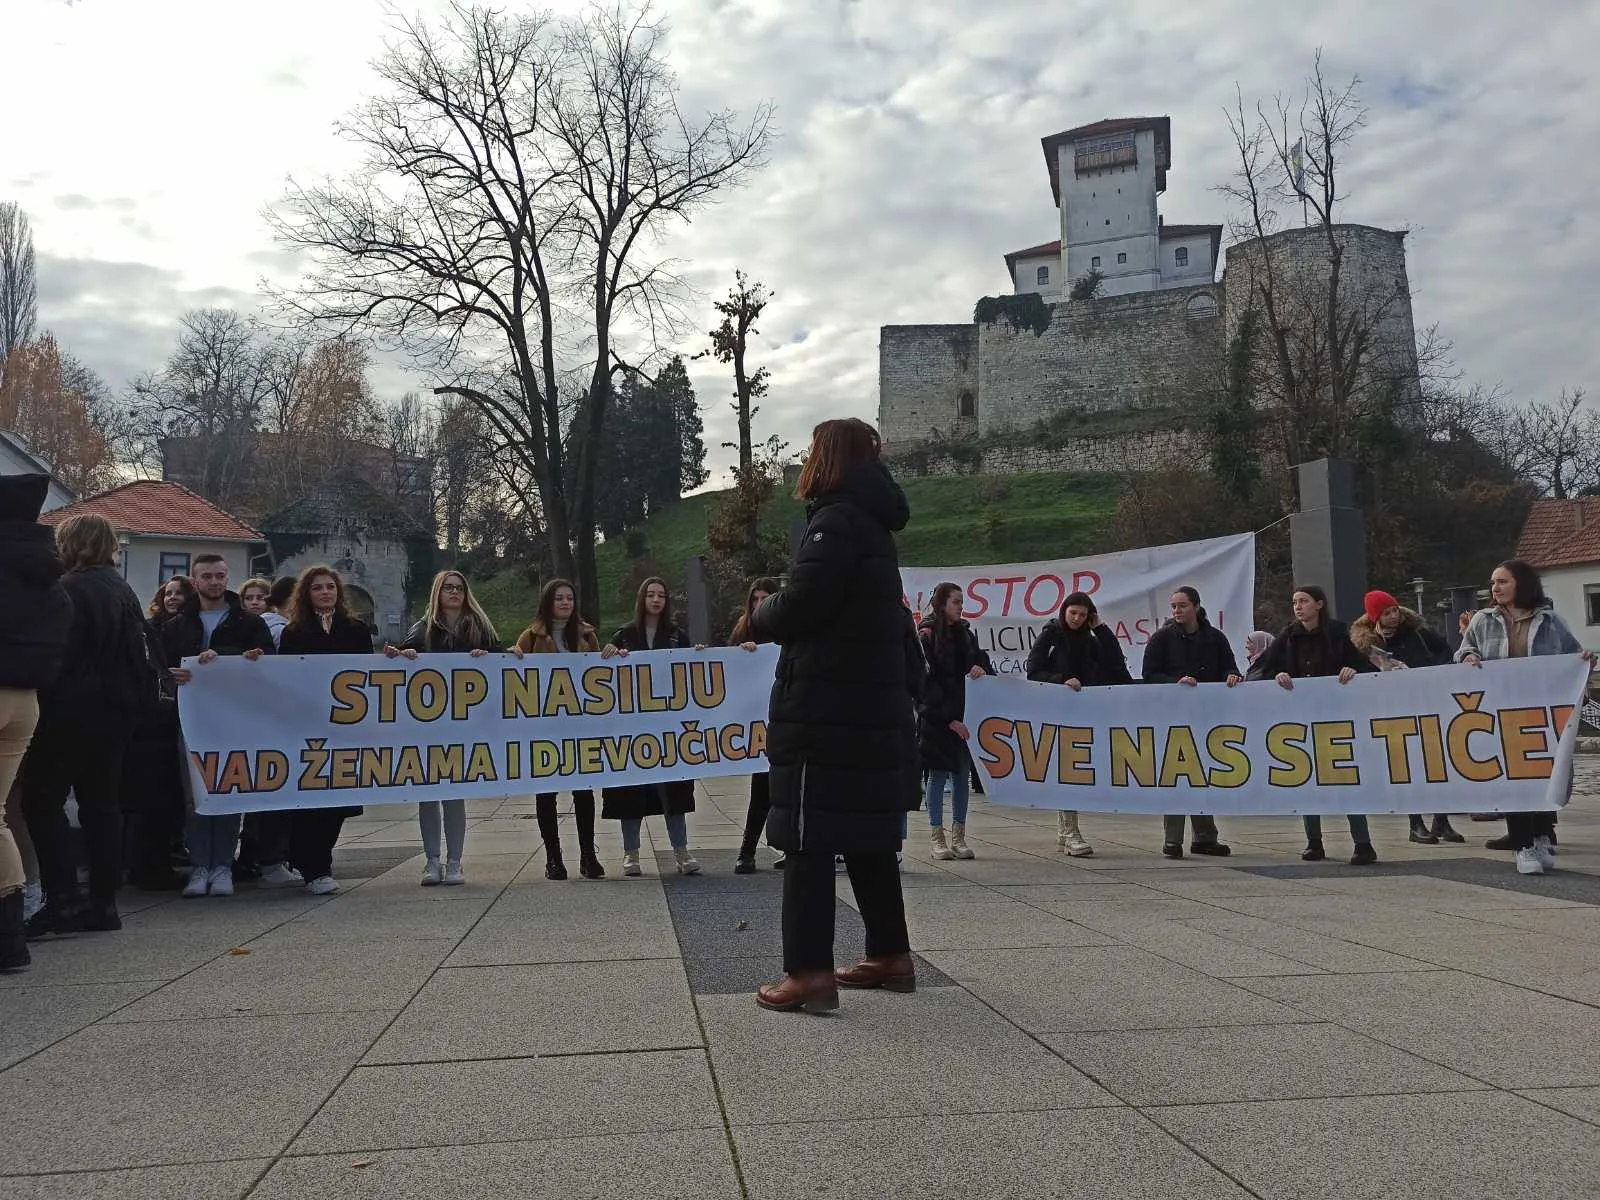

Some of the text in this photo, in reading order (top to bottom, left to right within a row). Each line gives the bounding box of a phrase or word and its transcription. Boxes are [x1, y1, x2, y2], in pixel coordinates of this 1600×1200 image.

[961, 570, 1102, 619] STOP
[330, 661, 727, 724] STOP NASILJU
[190, 720, 769, 795] NAD ŽENAMA I DJEVOJČICA
[977, 716, 1096, 786] SVE
[1109, 724, 1251, 788] NAS
[1266, 720, 1360, 787] SE
